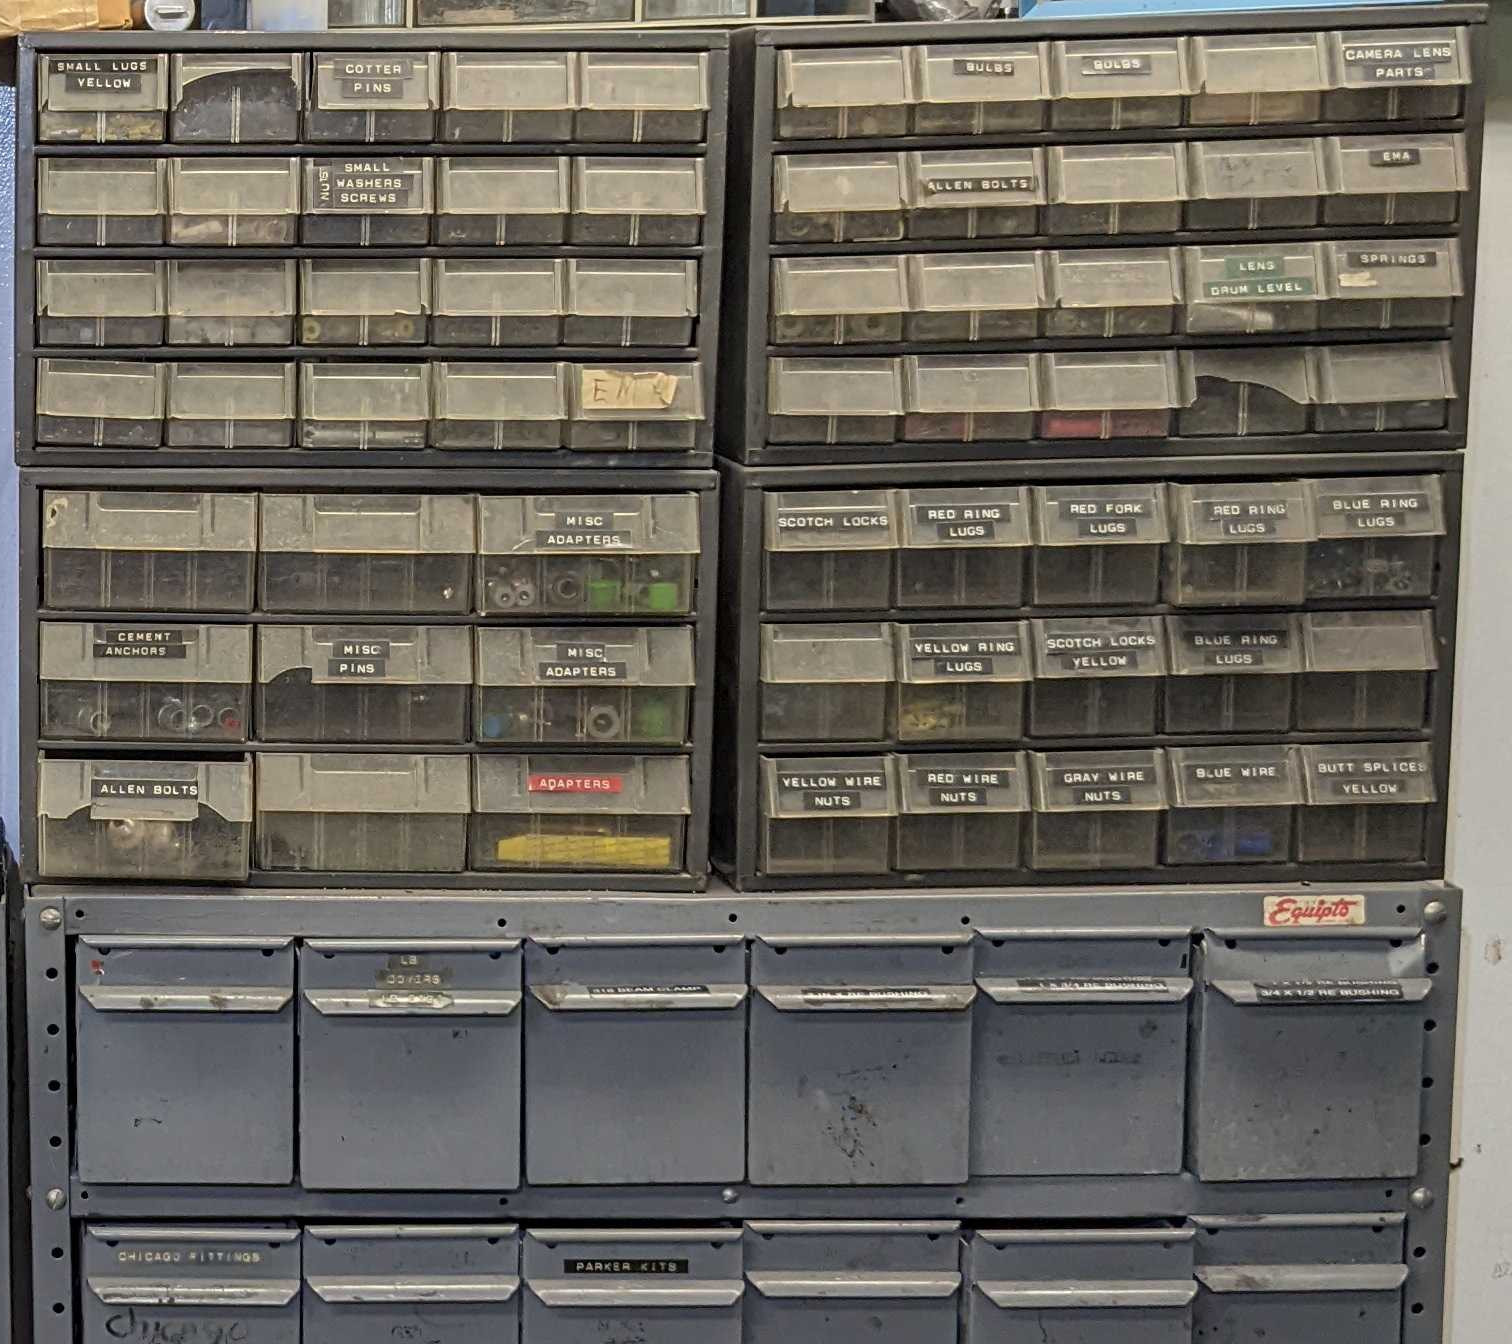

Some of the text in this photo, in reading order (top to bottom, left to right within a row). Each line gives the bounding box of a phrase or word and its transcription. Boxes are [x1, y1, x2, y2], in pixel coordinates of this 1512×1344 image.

[1344, 46, 1452, 61] CAMERA LENS
[56, 60, 148, 72] SMALL LUGS
[344, 63, 403, 75] COTTER
[966, 62, 1013, 74] BULBS
[1093, 59, 1141, 70] BULBS
[1375, 66, 1424, 79] PARTS
[76, 76, 132, 89] YELLOW
[353, 82, 392, 94] PINS
[344, 162, 391, 173] SMALL
[336, 177, 403, 189] WASHERS
[927, 178, 1029, 191] ALLEN BOLTS
[339, 192, 397, 204] SCREWS
[1359, 252, 1427, 265] SPRINGS
[1238, 260, 1276, 272] LENS
[1210, 282, 1303, 297] DRUM LEVEL
[1069, 503, 1144, 515] RED FORK
[1213, 503, 1286, 516] RED RING
[1332, 497, 1419, 511] BLUE RING
[927, 508, 1001, 521] RED RING
[565, 516, 604, 527] MISC
[777, 515, 889, 528] SCOTCH LOCKS
[1089, 522, 1127, 534] LUGS
[1356, 516, 1396, 528] LUGS
[948, 525, 985, 538] LUGS
[1228, 522, 1266, 535] LUGS
[546, 534, 622, 547] ADAPTERS
[117, 631, 171, 642] CEMENT
[1046, 634, 1156, 649] SCOTCH LOCKS
[1193, 634, 1279, 647] BLUE RING
[104, 645, 167, 657] ANCHORS
[343, 644, 380, 655] MISC
[566, 647, 604, 659] MISC
[914, 640, 1016, 655] YELLOW RING
[1071, 655, 1128, 668] YELLOW
[1215, 653, 1253, 665] LUGS
[339, 662, 375, 674] PINS
[544, 665, 617, 678] ADAPTERS
[945, 660, 983, 673] LUGS
[1195, 765, 1277, 779] BLUE WIRE
[1317, 761, 1428, 774] BUTT SPLICES
[537, 776, 612, 790] ADAPTERS
[782, 774, 882, 788] YELLOW WIRE
[927, 772, 999, 785] RED WIRE
[1063, 770, 1145, 784] GRAY WIRE
[99, 782, 199, 797] ALLEN BOLTS
[1341, 782, 1400, 795] YELLOW
[814, 795, 852, 808] NUTS
[939, 791, 977, 803] NUTS
[1084, 790, 1121, 802] NUTS
[1268, 898, 1358, 923] Equipto
[575, 1260, 678, 1273] PARKER KITS
